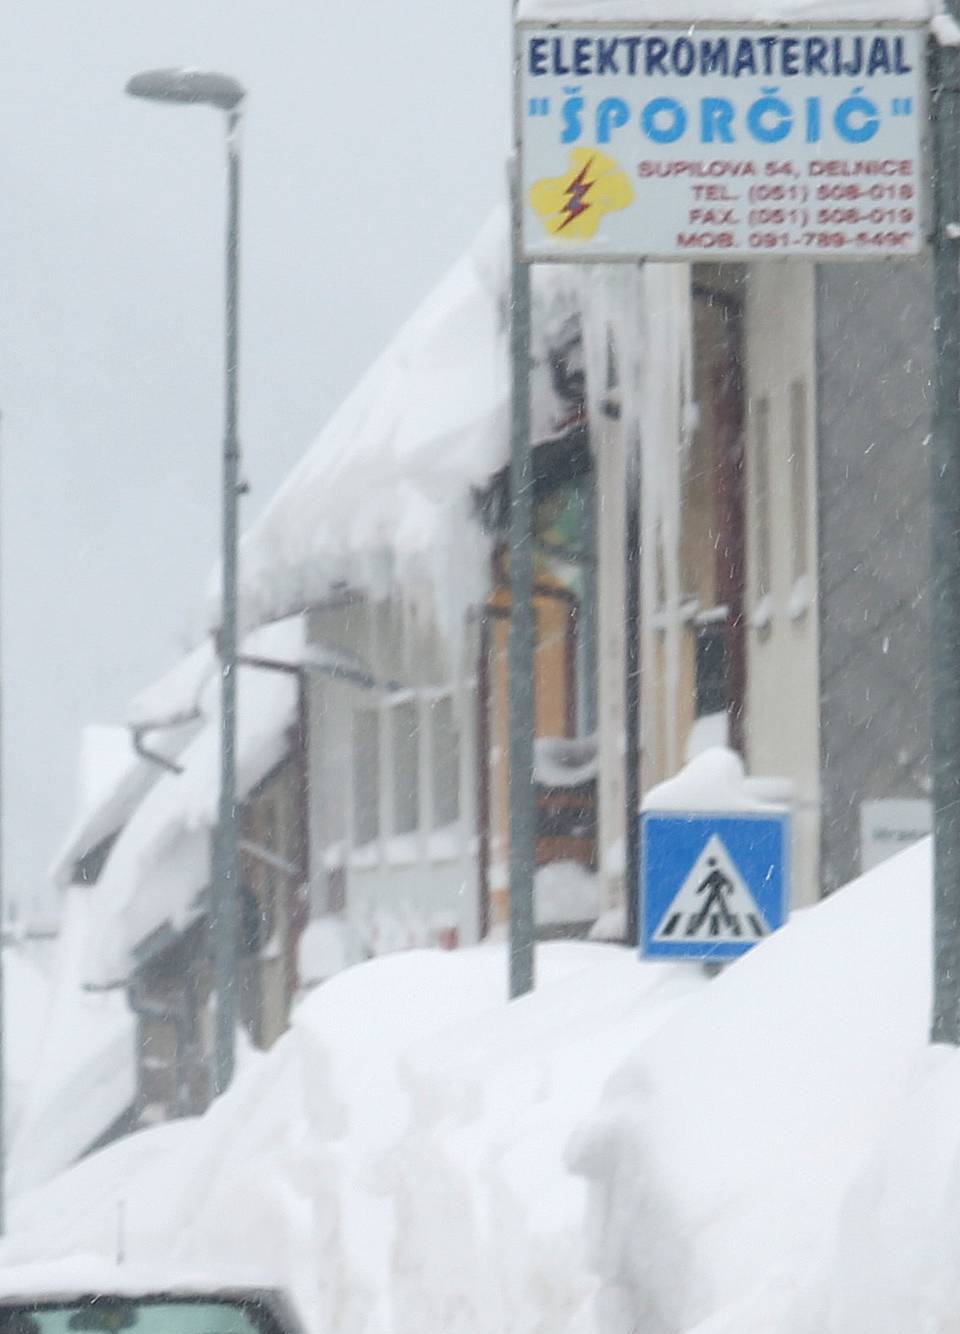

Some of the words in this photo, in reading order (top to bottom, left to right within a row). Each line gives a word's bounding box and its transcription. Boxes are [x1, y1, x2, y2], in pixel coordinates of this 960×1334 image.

[528, 36, 911, 77] ELEKTROMATERIJAL
[528, 85, 912, 145] "ŠPORČIĆ"
[637, 160, 755, 177] SUPILOVA
[809, 160, 913, 177] DELNICE
[691, 184, 740, 201] TEL.
[688, 208, 740, 225] FAX.
[676, 231, 739, 249] MOB.
